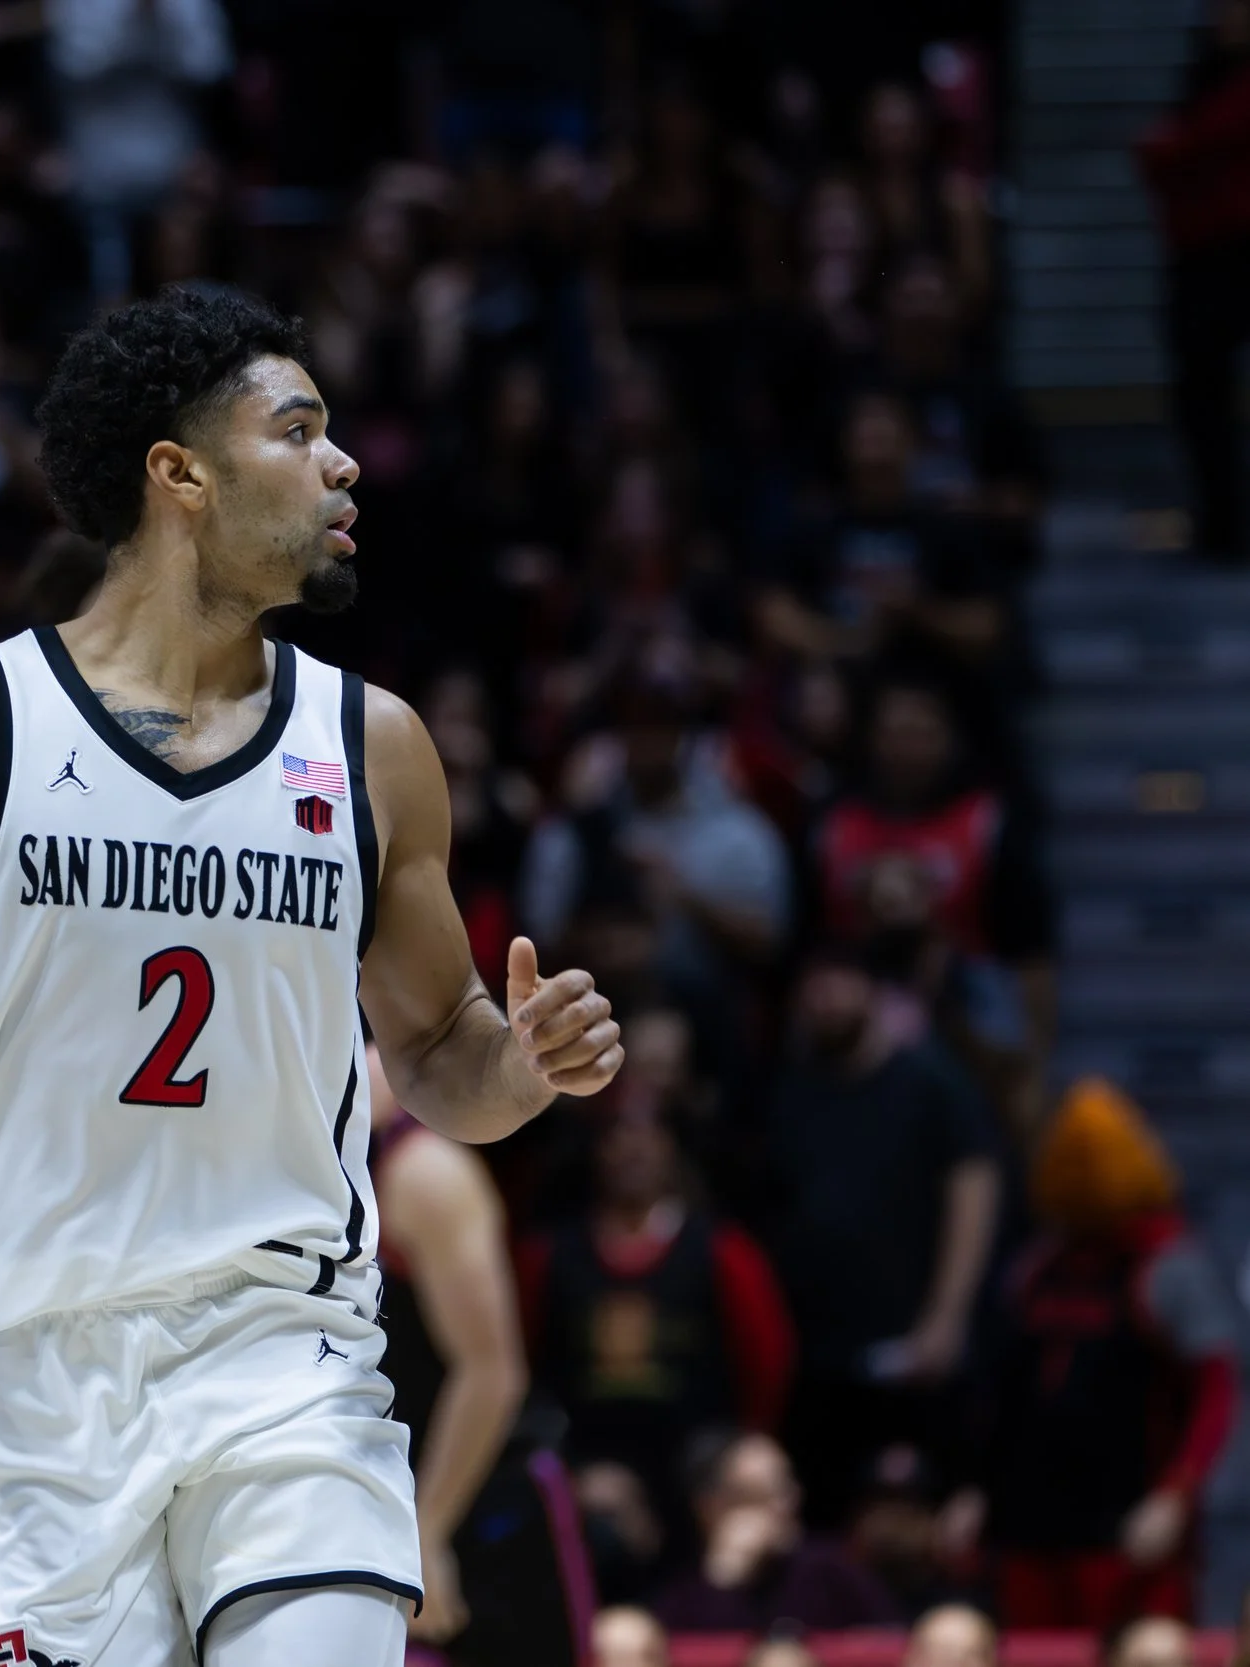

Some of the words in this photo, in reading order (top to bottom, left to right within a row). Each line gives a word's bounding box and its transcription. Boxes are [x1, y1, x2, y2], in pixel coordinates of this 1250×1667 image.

[19, 833, 92, 908] SAN
[101, 838, 226, 919] DIEGO
[233, 848, 344, 932] STATE
[119, 945, 216, 1108] 2
